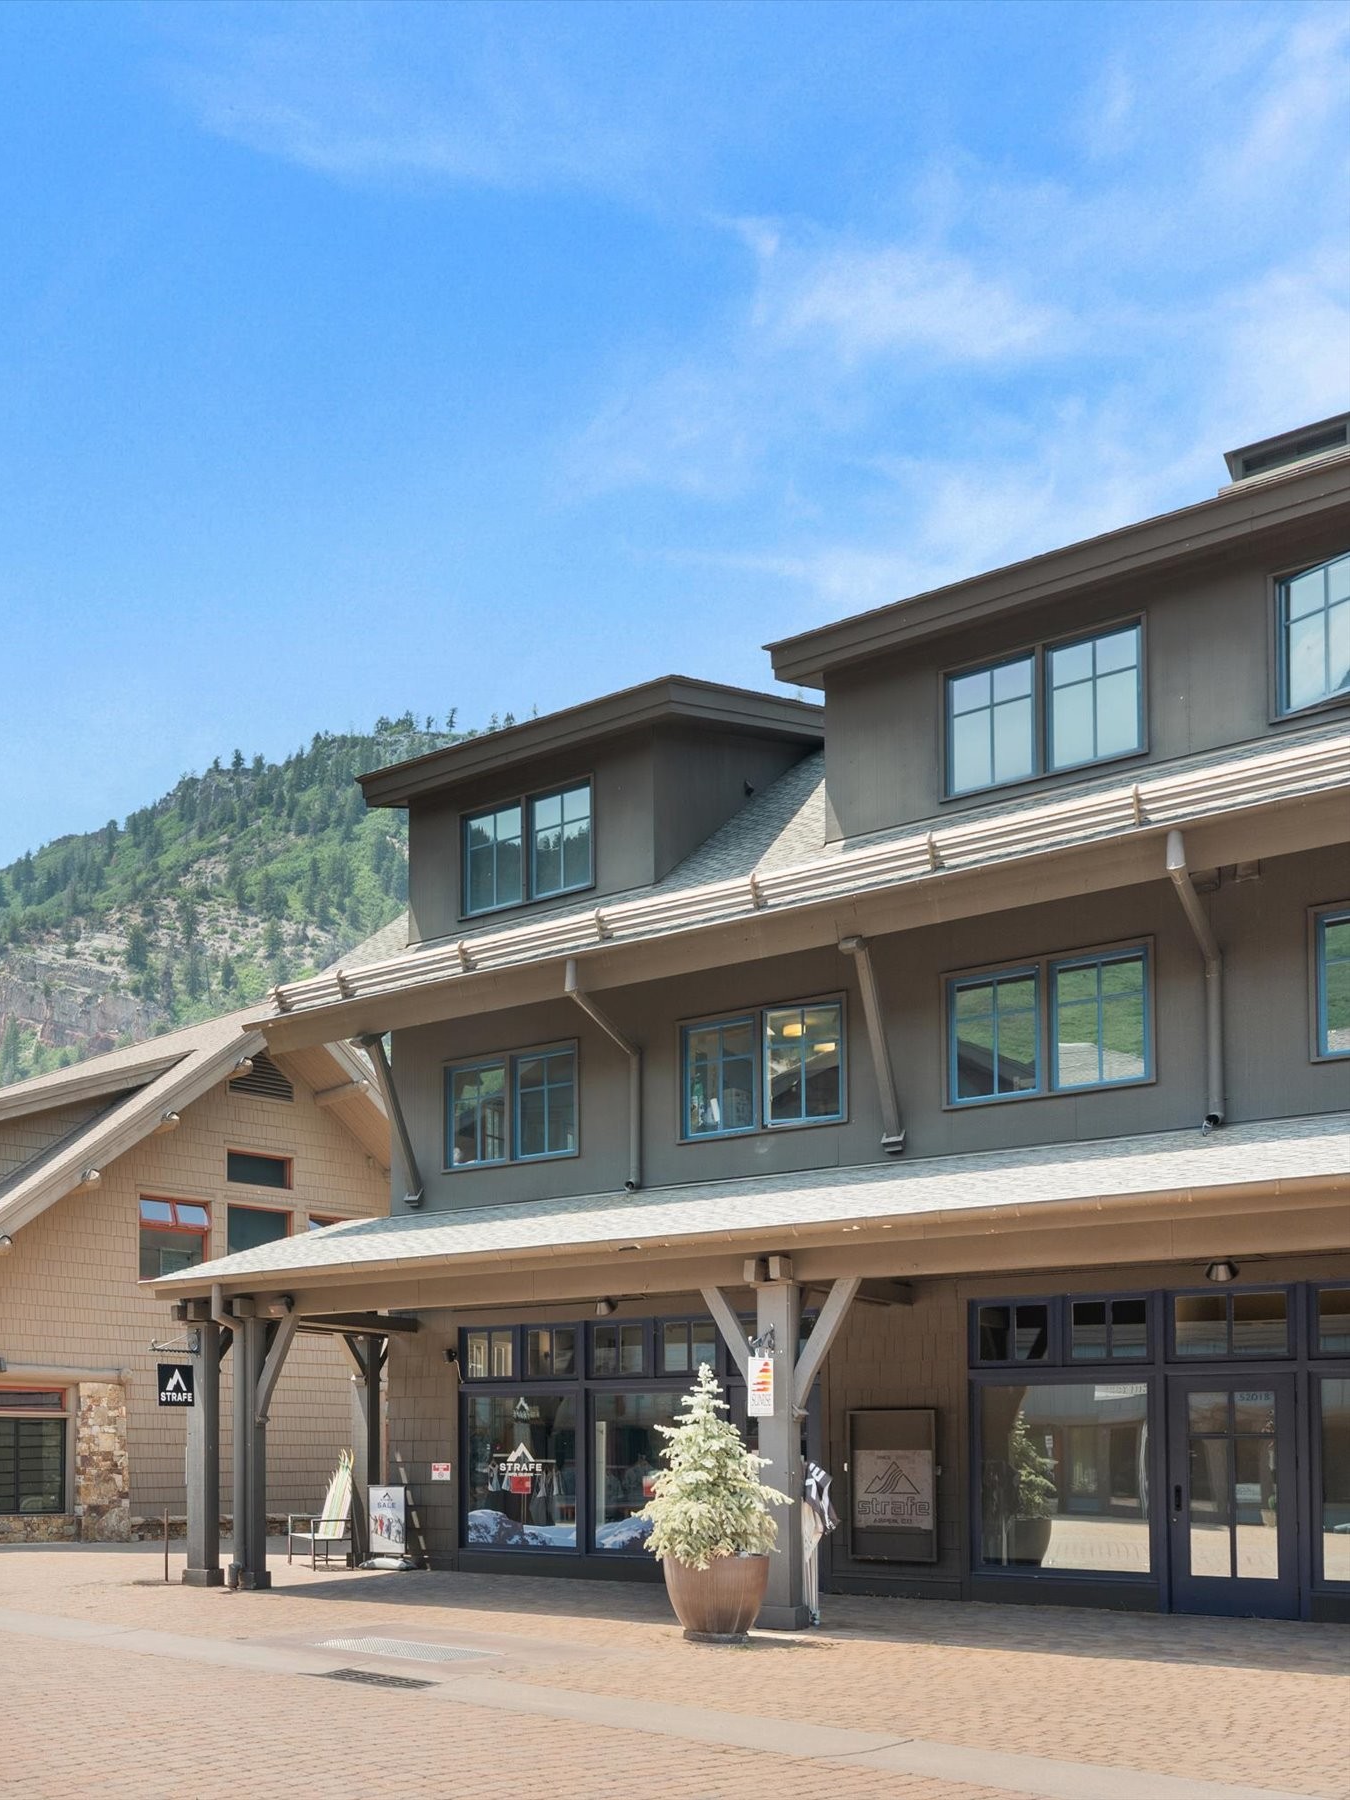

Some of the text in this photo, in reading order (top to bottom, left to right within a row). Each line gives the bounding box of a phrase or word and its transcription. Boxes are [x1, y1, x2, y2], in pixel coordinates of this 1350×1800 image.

[160, 1391, 193, 1402] STRAFE
[499, 1462, 542, 1472] STRAFE
[857, 1496, 930, 1516] strafe
